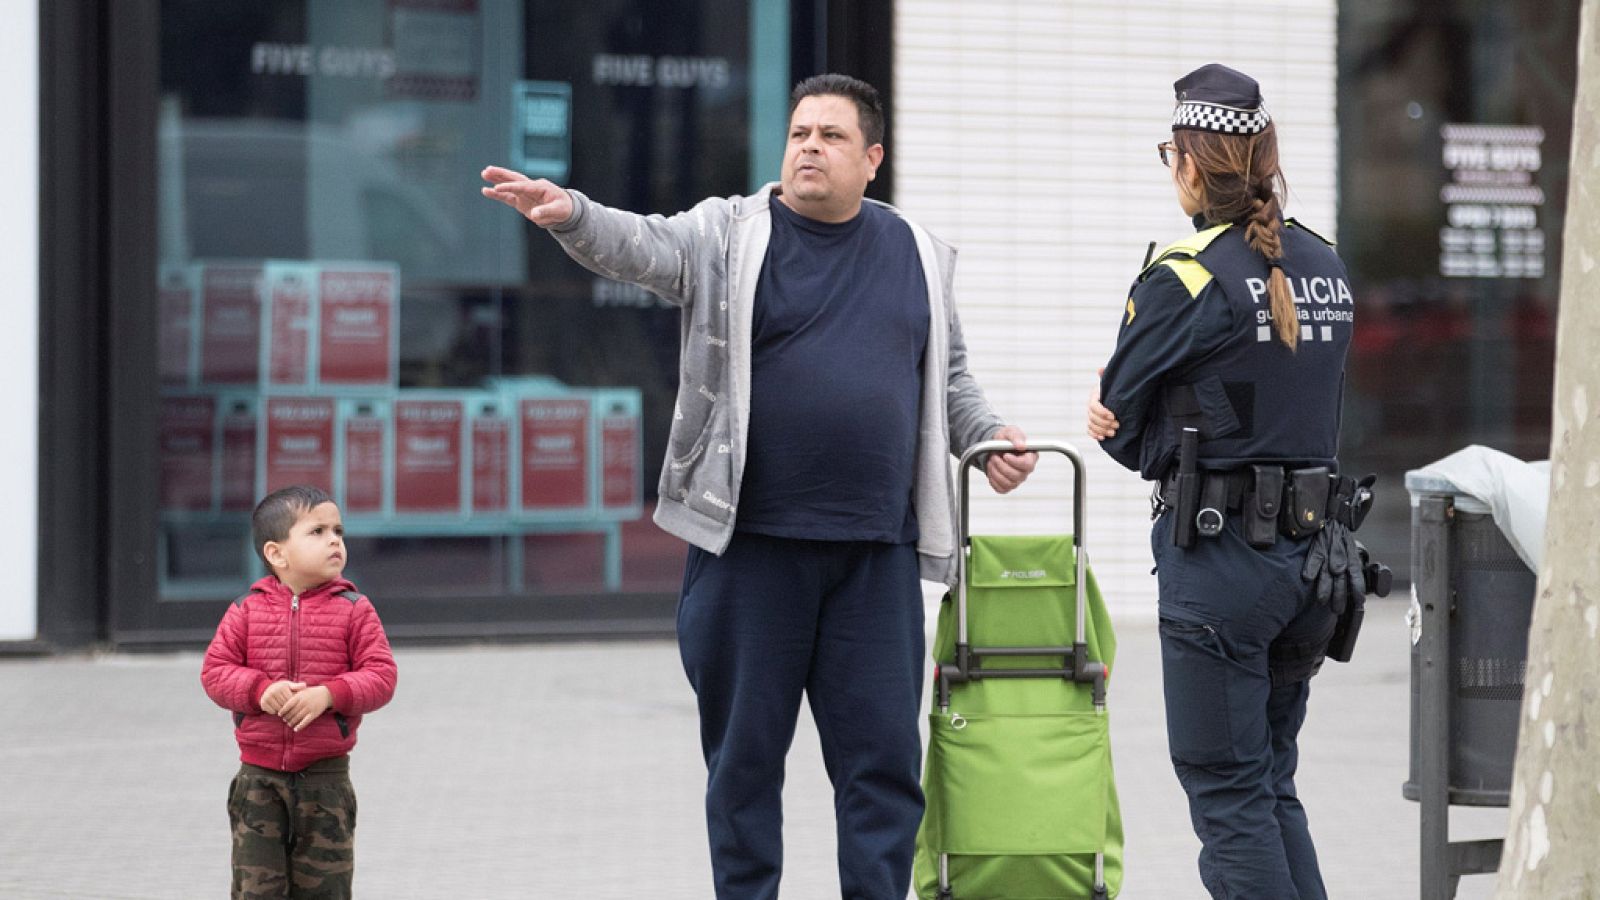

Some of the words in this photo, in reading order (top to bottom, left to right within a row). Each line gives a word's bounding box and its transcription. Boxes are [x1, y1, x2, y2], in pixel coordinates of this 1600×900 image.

[251, 43, 312, 75] FIVE
[318, 46, 396, 79] GUYS
[592, 55, 654, 86] FIVE
[657, 57, 730, 88] GUYS
[1245, 276, 1354, 305] PLICIA
[1256, 306, 1310, 323] guia
[1313, 307, 1354, 322] urbana
